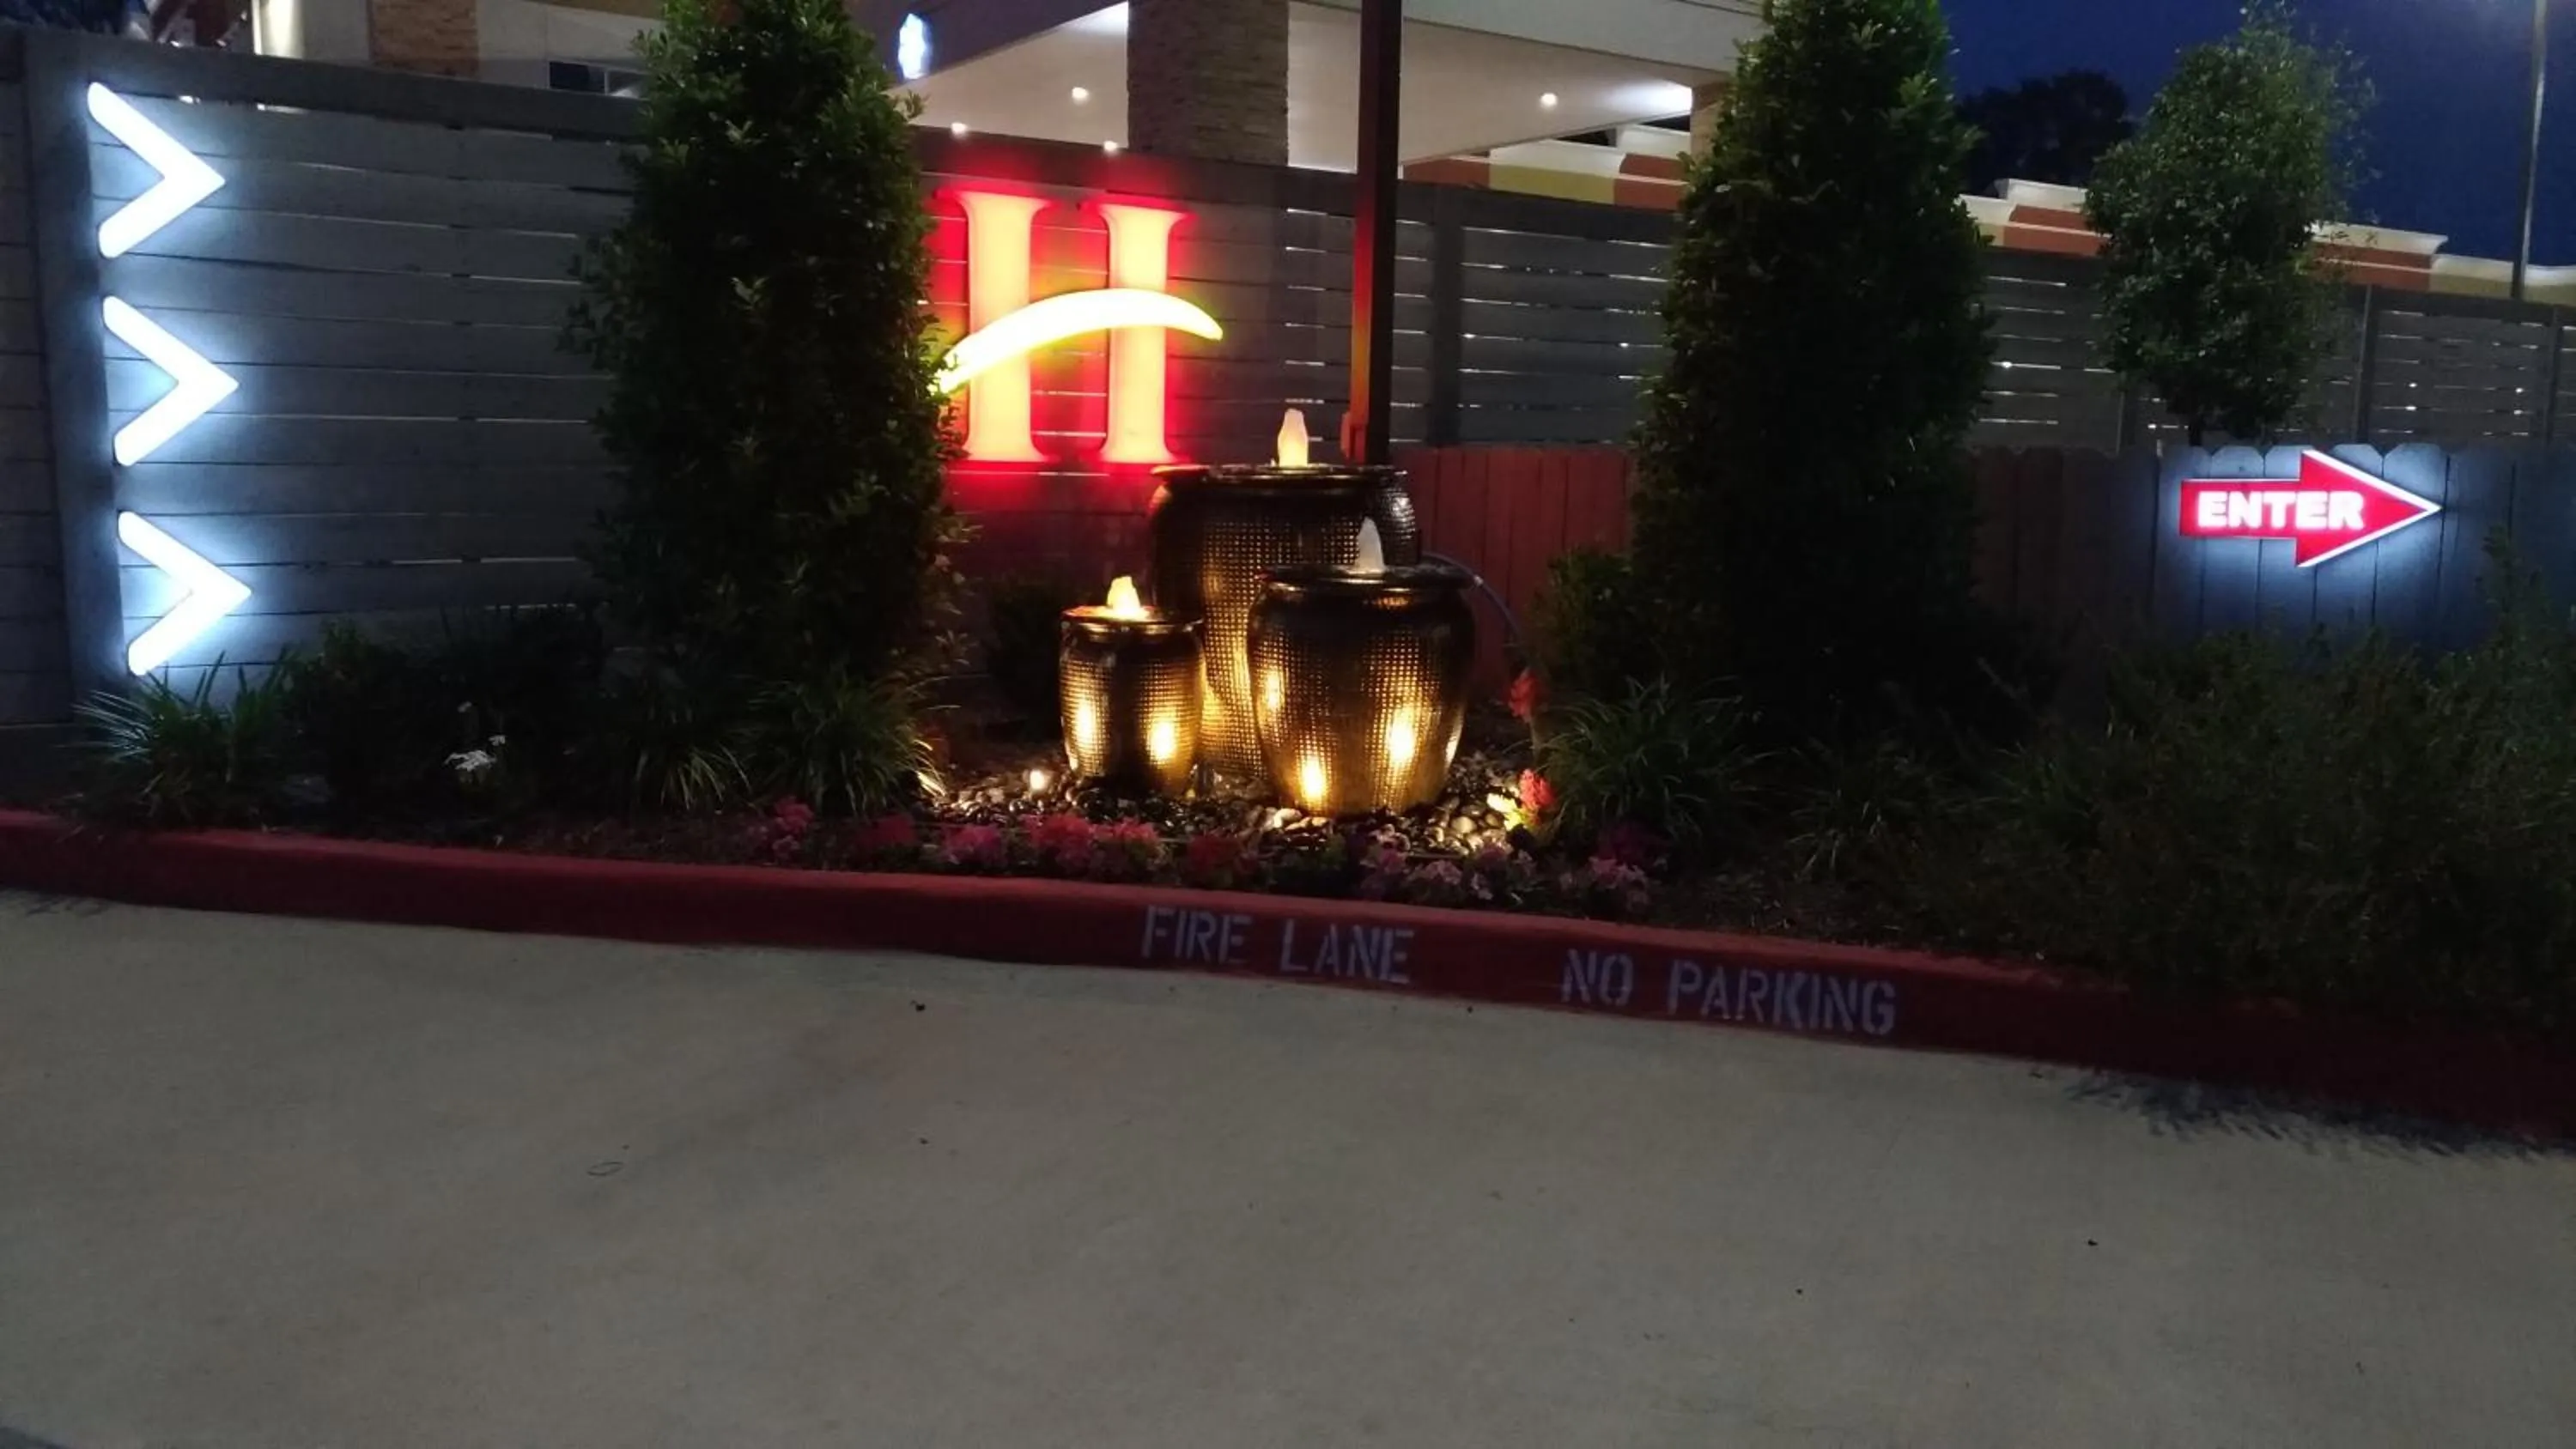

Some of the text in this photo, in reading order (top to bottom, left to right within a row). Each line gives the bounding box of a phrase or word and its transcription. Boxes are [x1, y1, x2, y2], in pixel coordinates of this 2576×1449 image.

[2196, 489, 2366, 531] ENTER
[1140, 904, 1897, 1035] FIRE LANE NO PARKING
